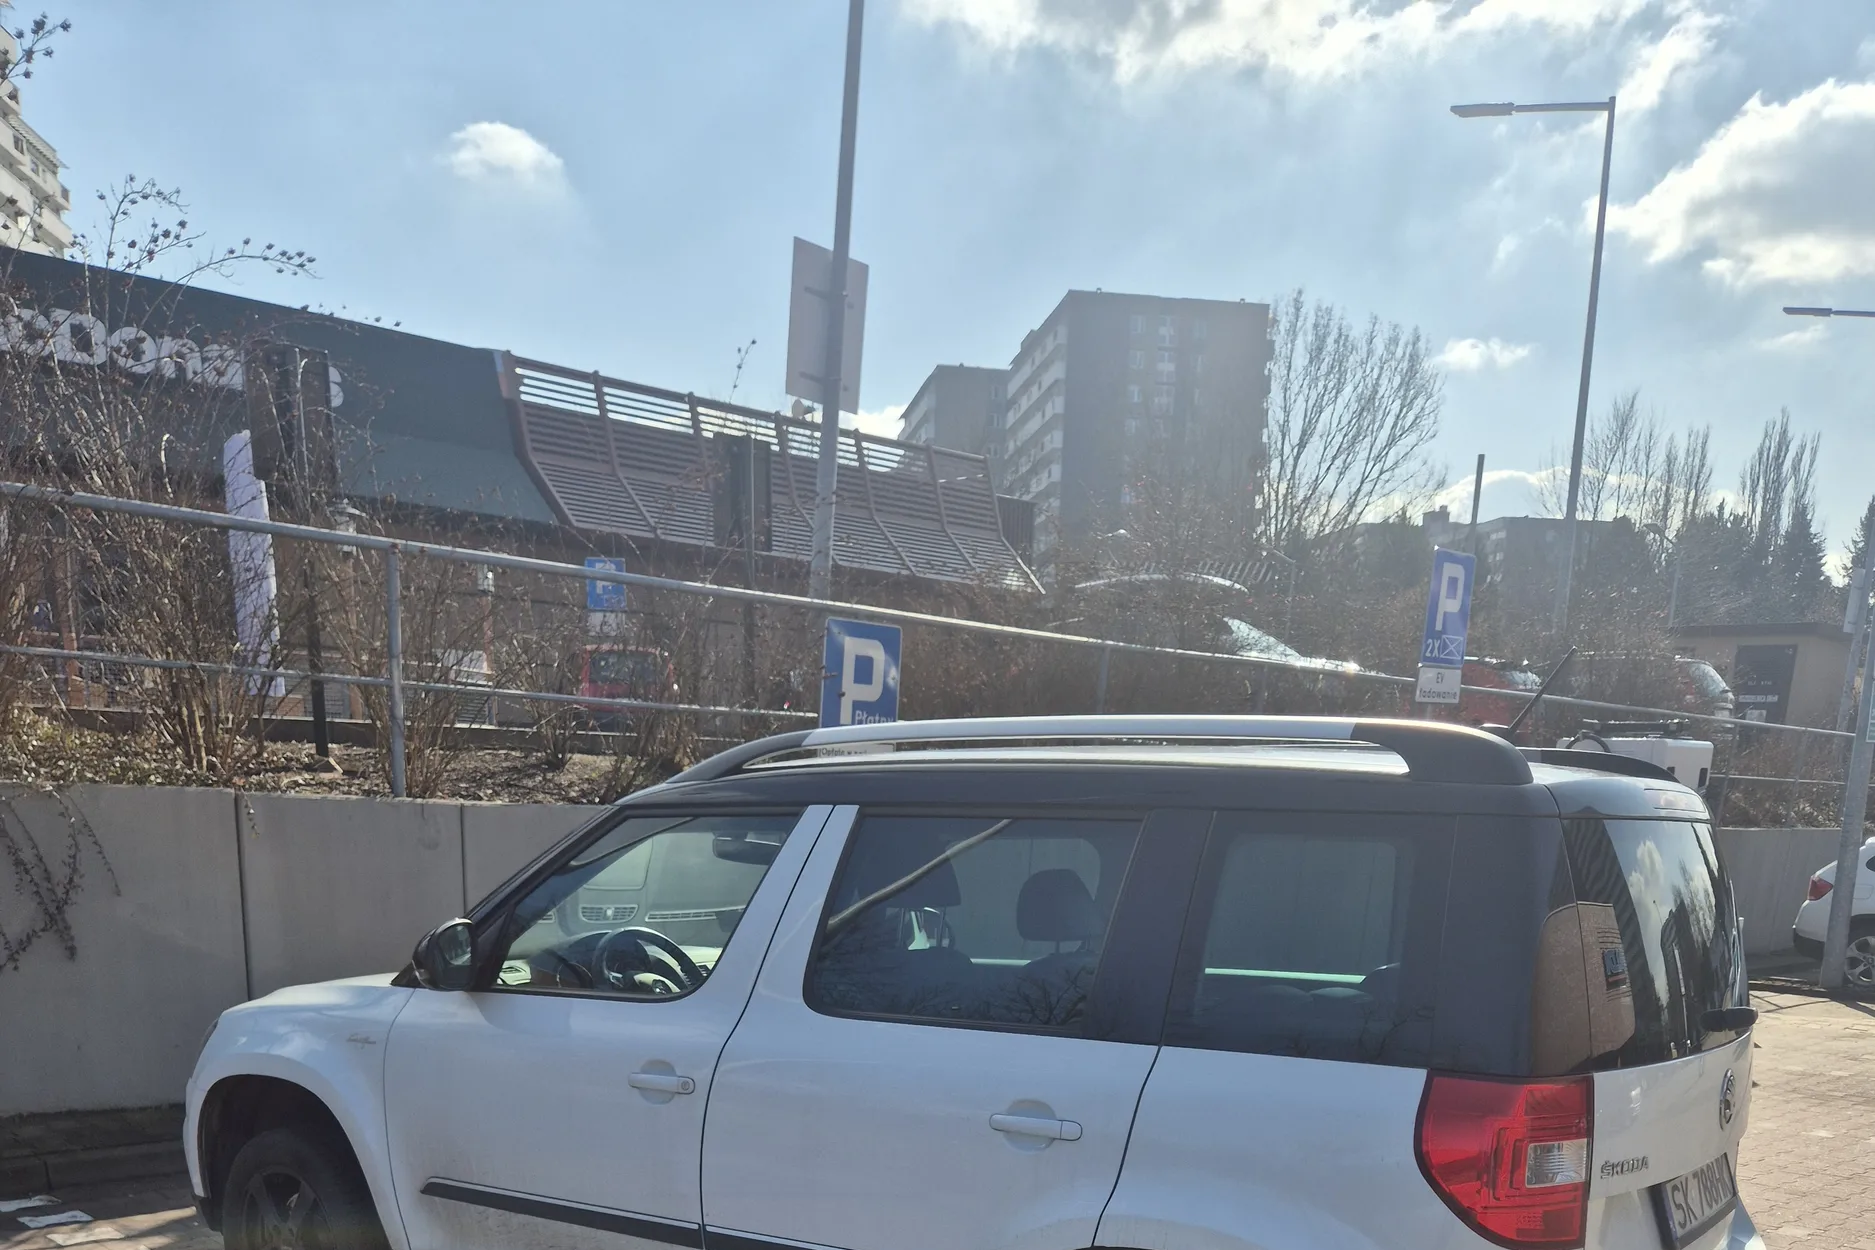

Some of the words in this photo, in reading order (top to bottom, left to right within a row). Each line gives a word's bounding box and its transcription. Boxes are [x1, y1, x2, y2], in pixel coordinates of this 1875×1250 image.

[1435, 562, 1465, 631] P
[840, 636, 885, 725] P
[1436, 672, 1445, 684] EV
[1600, 1156, 1648, 1179] ŠKODA
[1671, 1176, 1698, 1229] SK
